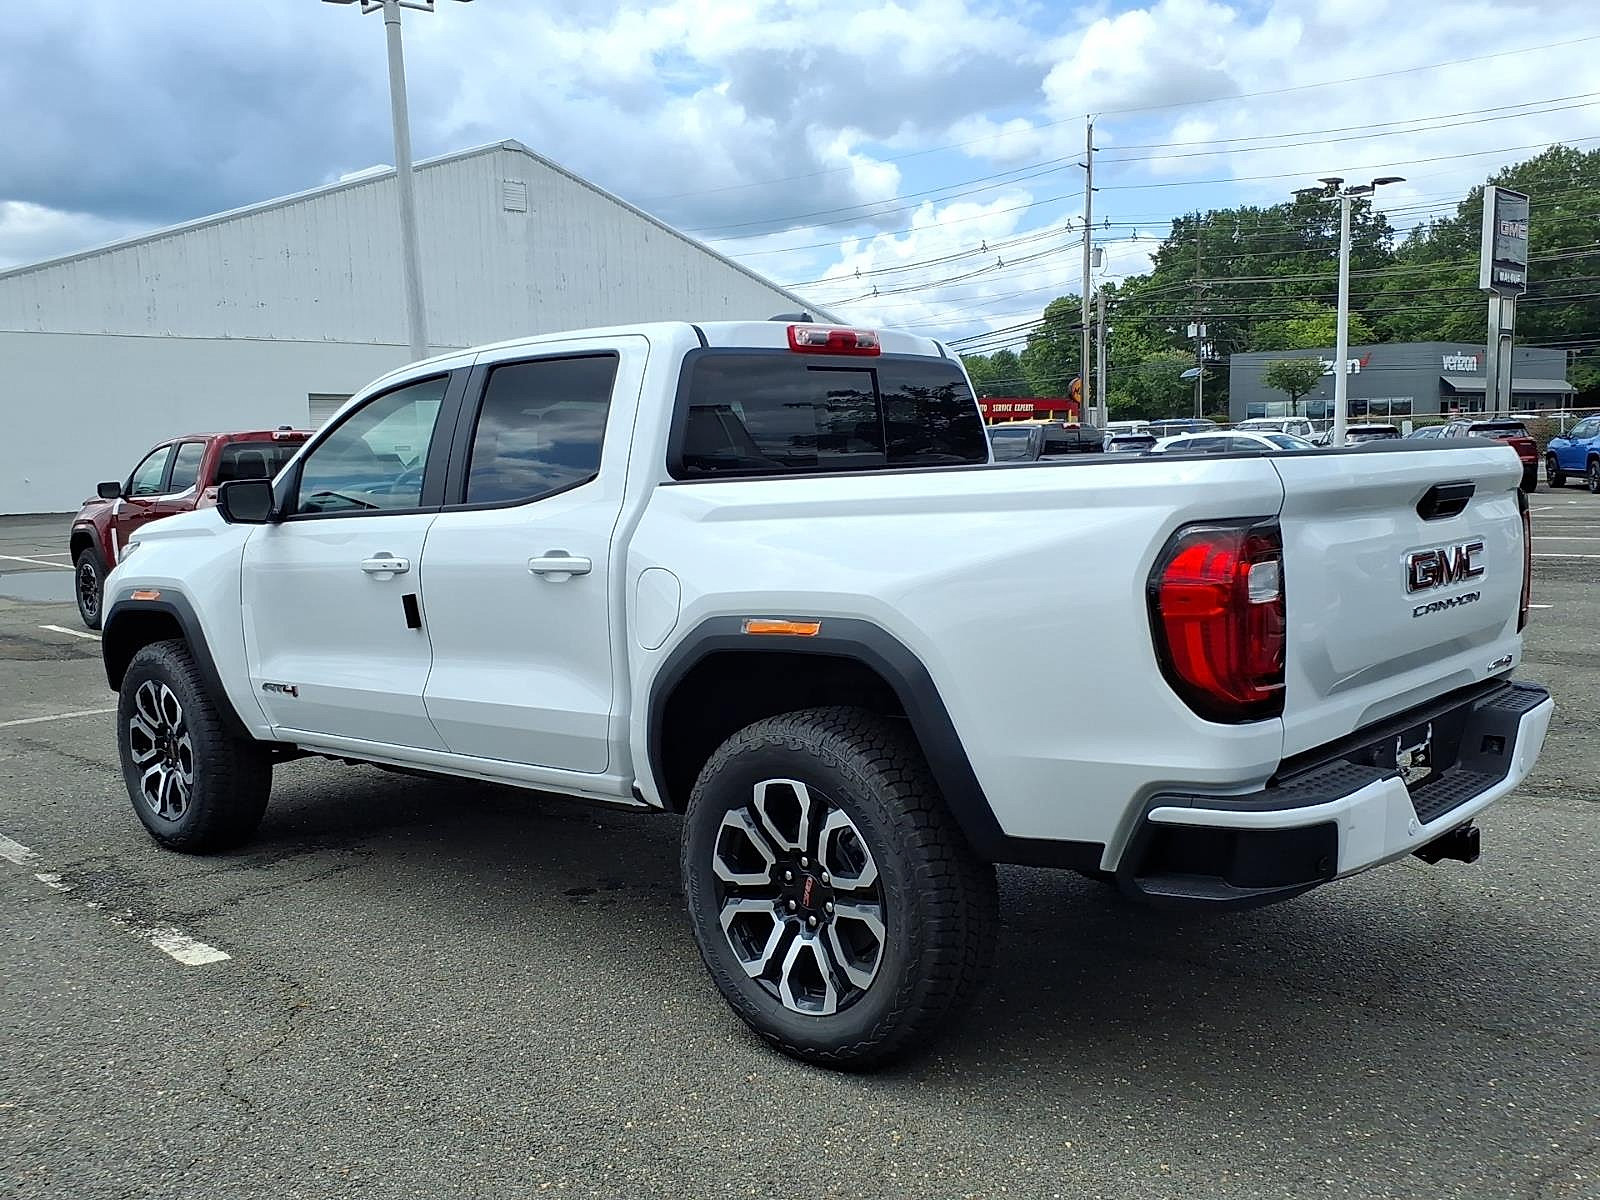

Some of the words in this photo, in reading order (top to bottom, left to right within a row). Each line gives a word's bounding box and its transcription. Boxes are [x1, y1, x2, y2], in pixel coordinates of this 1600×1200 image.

[1442, 351, 1477, 371] verizon
[992, 403, 1012, 412] SERVICE
[1014, 403, 1034, 412] EXPERTS
[1407, 541, 1485, 593] GMC
[1412, 591, 1481, 618] CANYON
